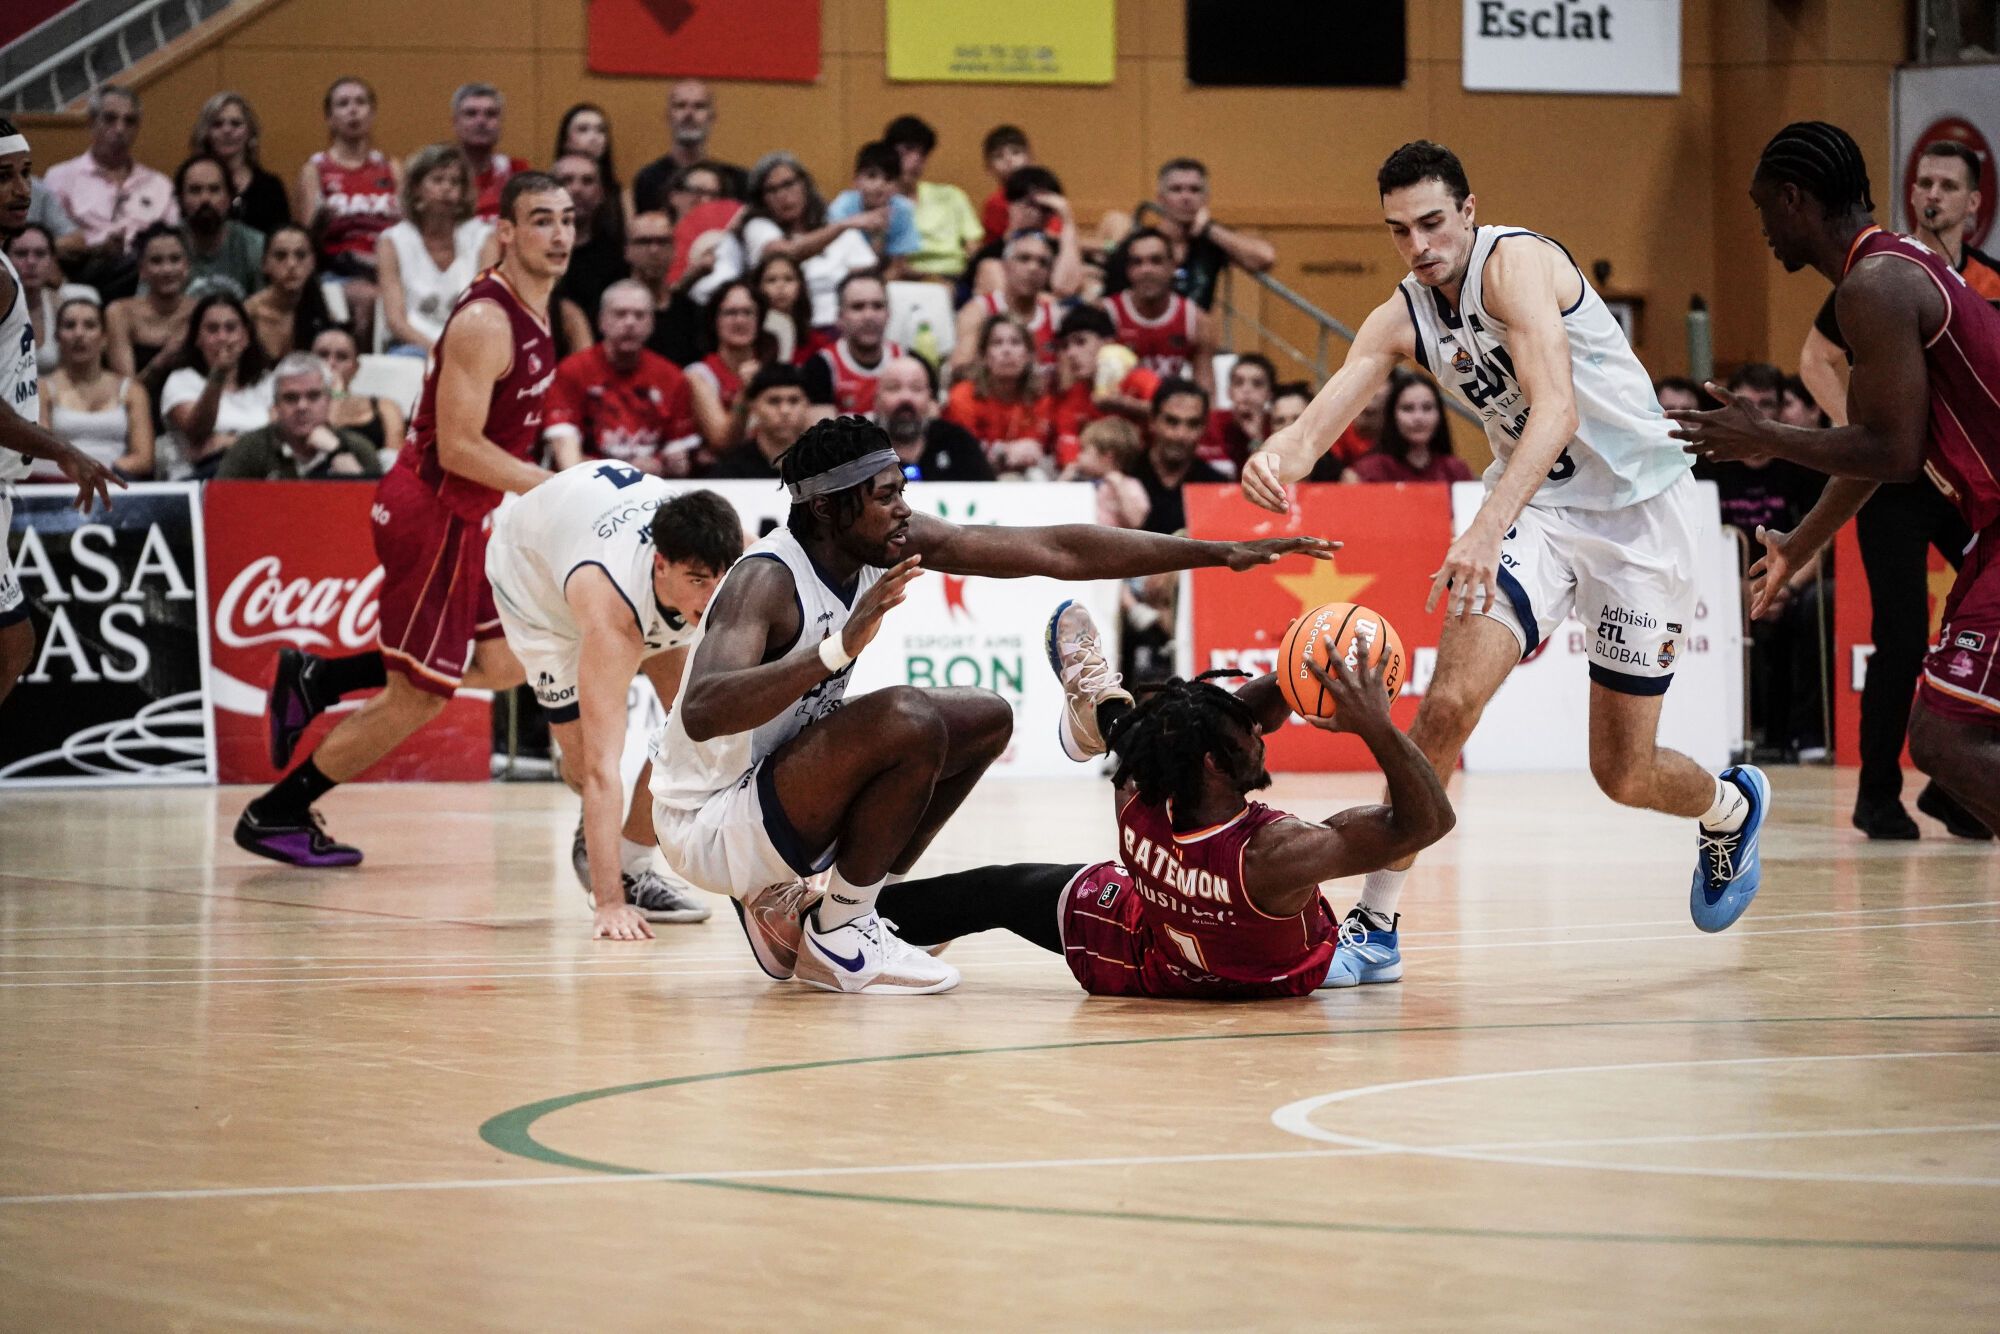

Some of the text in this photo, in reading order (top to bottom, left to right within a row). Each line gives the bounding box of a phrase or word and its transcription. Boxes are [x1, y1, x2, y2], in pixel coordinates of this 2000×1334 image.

[1479, 1, 1612, 40] Esclat
[1600, 604, 1657, 630] Adbisio
[17, 604, 151, 684] AS
[1597, 621, 1626, 645] ETL
[1957, 636, 1977, 647] acb
[1595, 640, 1651, 667] GLOBAL
[905, 655, 1023, 693] BON
[1386, 654, 1401, 688] acb
[1123, 824, 1233, 904] BATEMON
[1101, 885, 1114, 902] acb
